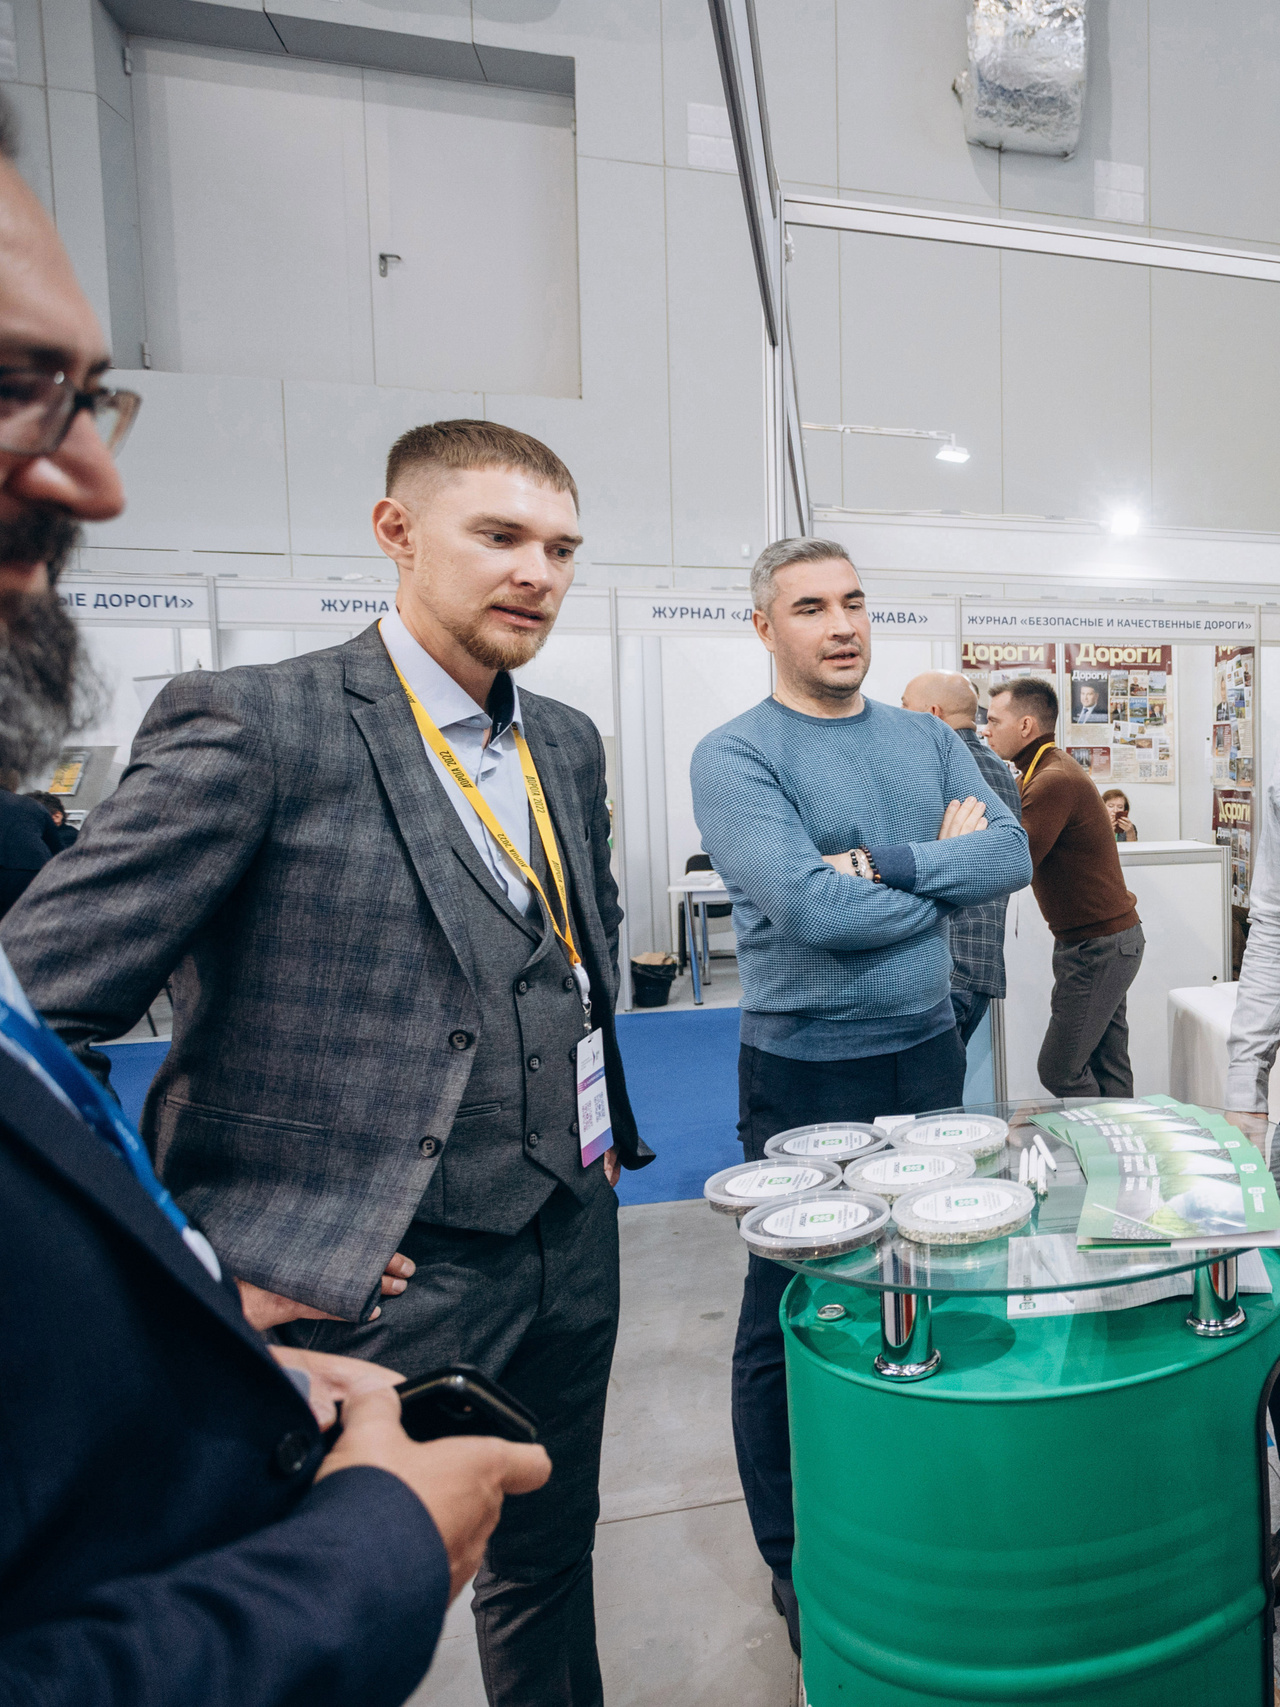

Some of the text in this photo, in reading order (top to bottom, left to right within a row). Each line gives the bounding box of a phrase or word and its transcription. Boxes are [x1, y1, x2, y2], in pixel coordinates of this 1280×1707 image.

[93, 593, 194, 609] ДОРОГИ»
[321, 599, 391, 613] ЖУРНА
[652, 606, 725, 621] ЖУРНАЛ
[868, 612, 929, 624] ЖАВА»
[967, 615, 1252, 630] ЖУРНАЛ «БЕЗОПАСНЫЕ И КАЧЕСТВЕННЫЕ ДОРОГИ»
[962, 642, 1044, 665] Дороги
[1076, 643, 1161, 666] Дороги
